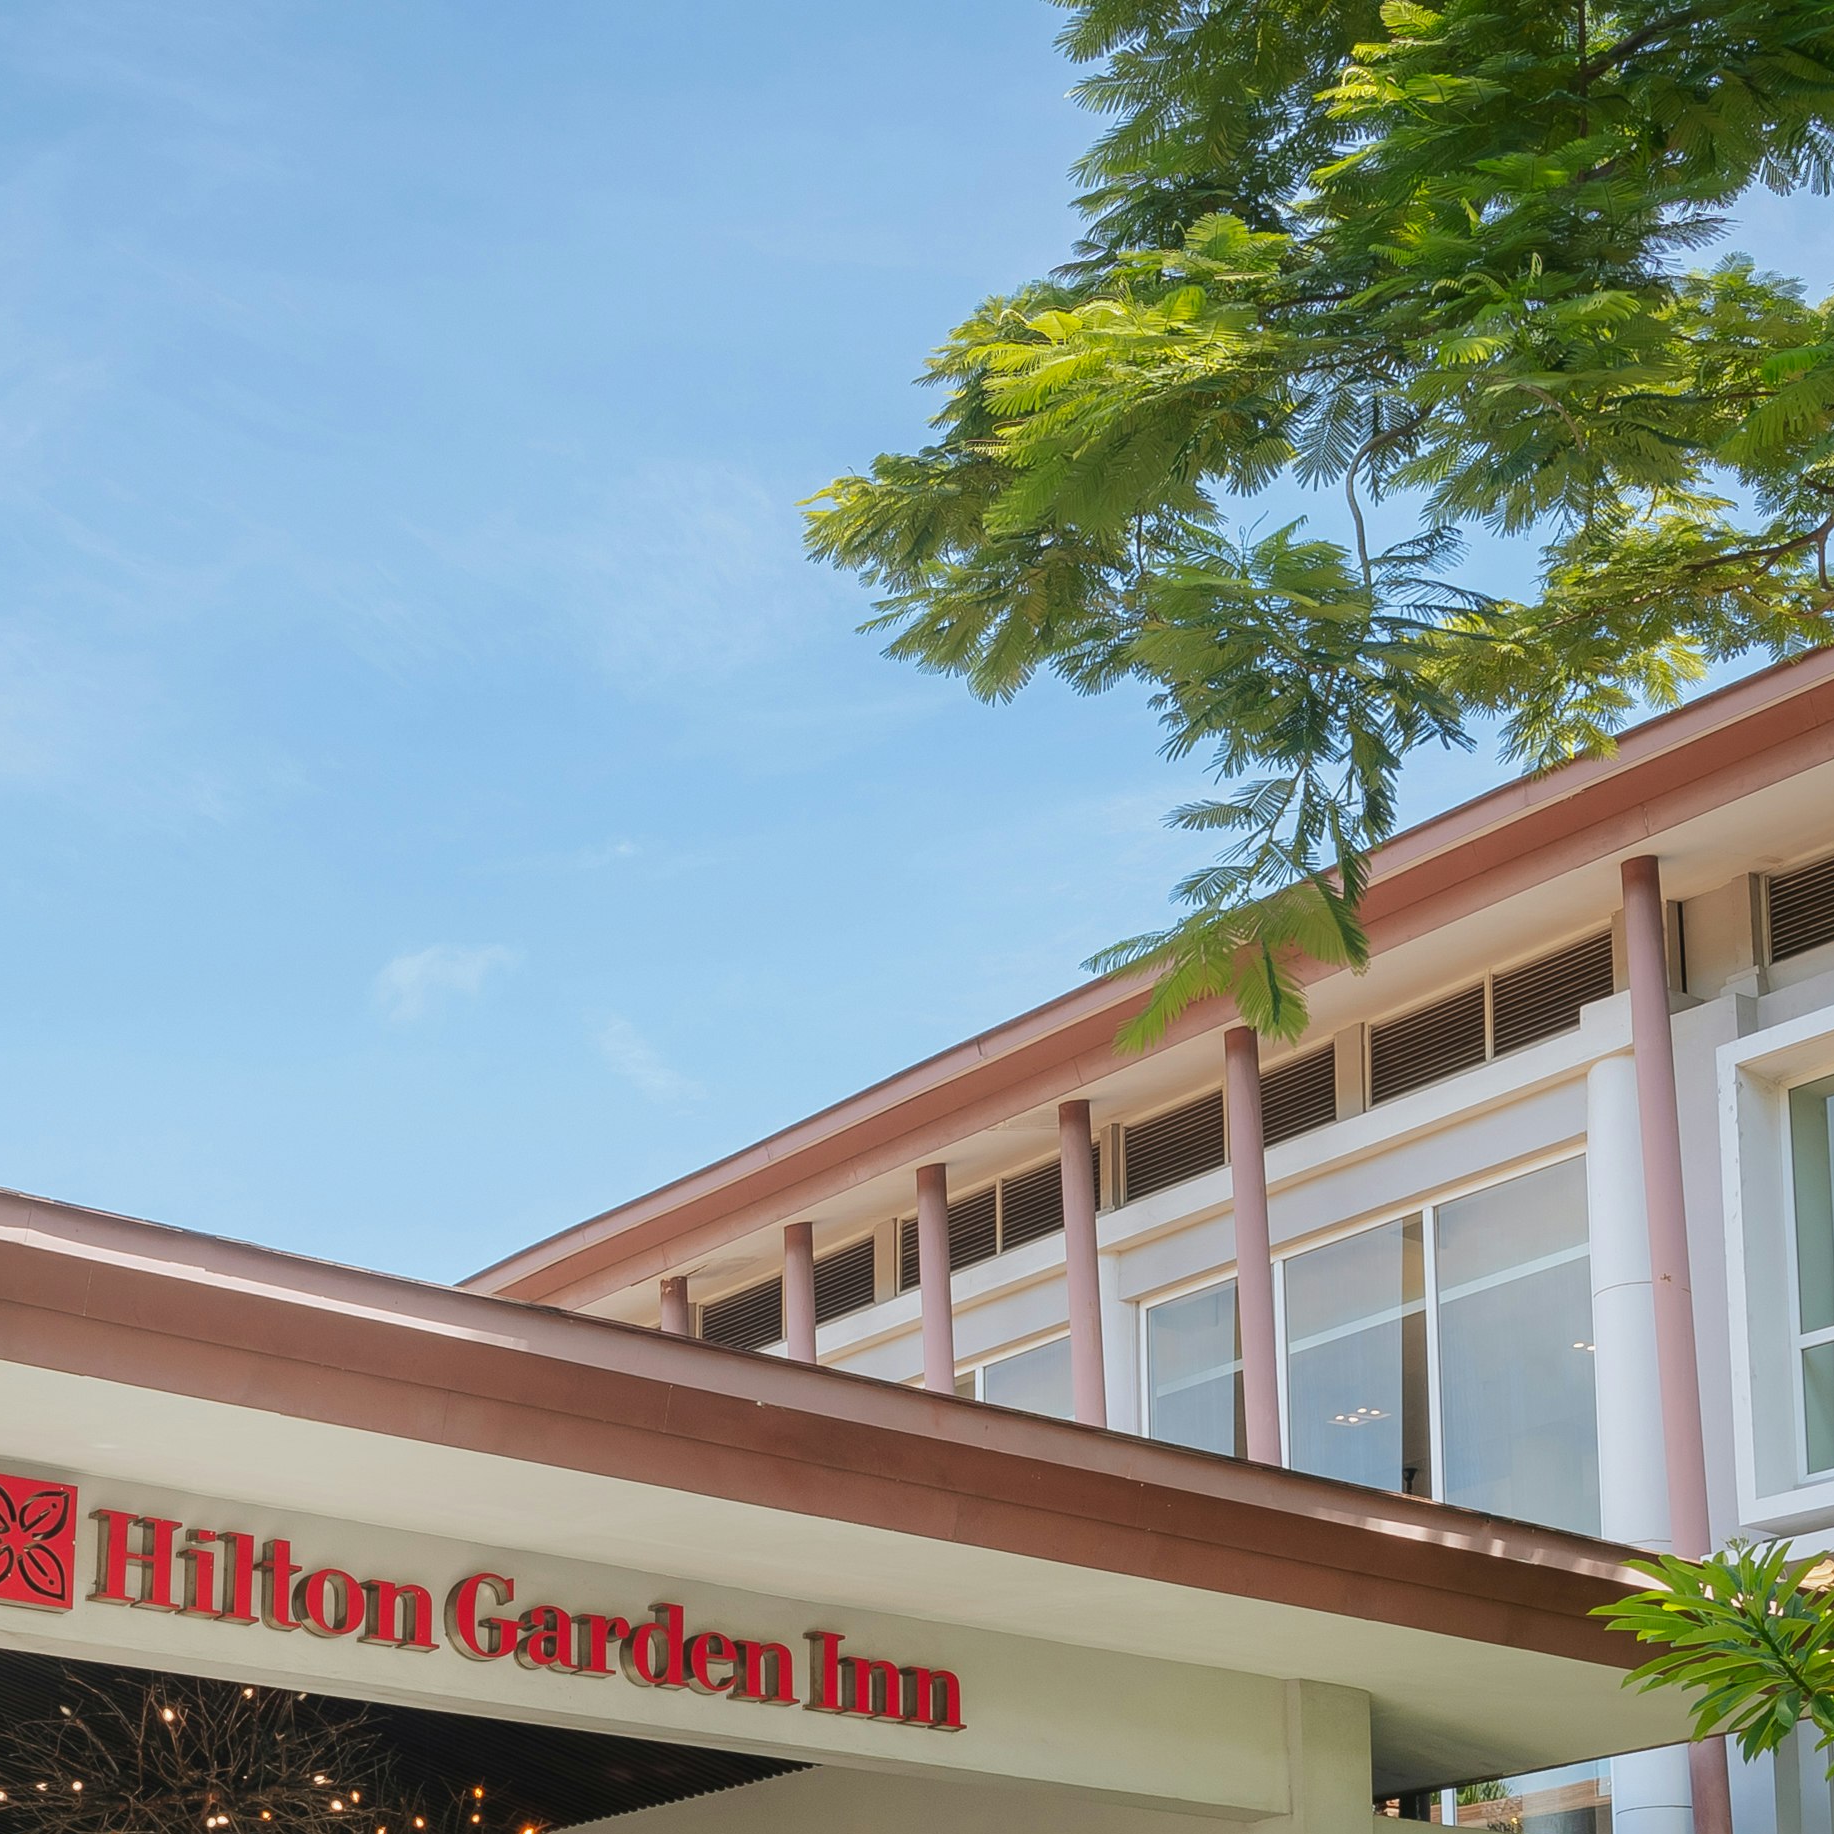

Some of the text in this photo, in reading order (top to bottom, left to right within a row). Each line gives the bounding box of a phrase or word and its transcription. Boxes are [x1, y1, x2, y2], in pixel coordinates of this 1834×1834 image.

[88, 1509, 967, 1732] Hilton Garden Inn
